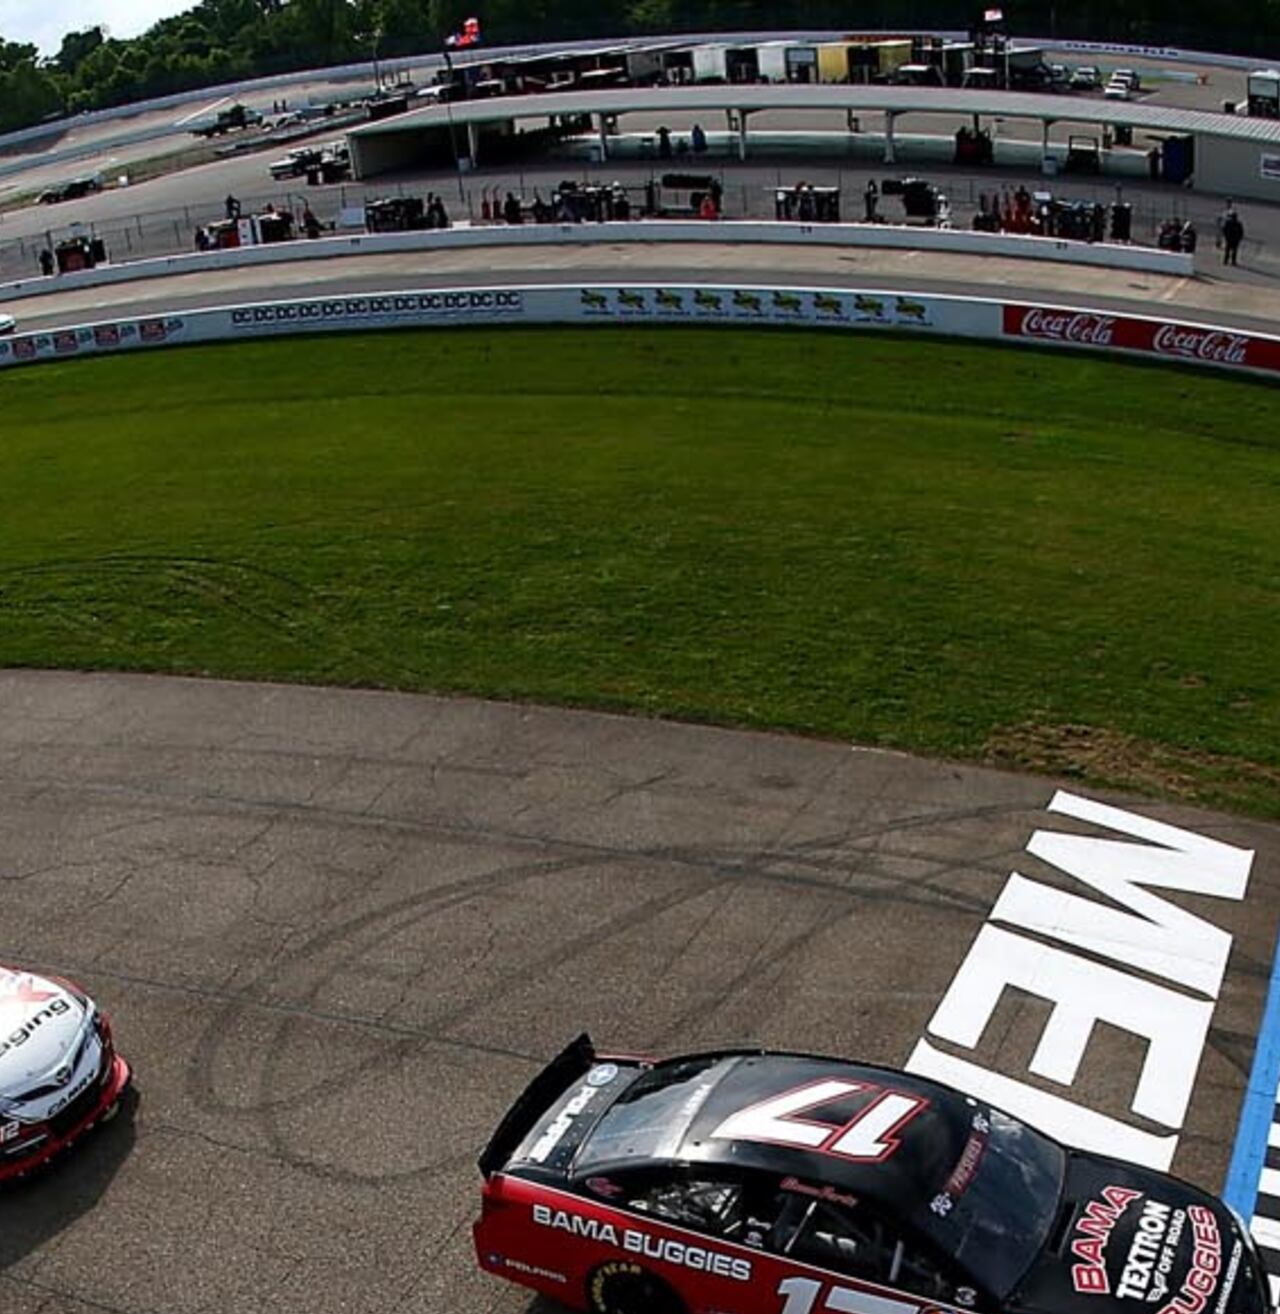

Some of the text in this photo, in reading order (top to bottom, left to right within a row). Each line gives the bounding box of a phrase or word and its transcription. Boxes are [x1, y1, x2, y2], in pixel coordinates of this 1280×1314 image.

[1022, 309, 1116, 345] Coca-Cola
[1153, 324, 1248, 364] Coca-Cola
[710, 1076, 930, 1162] 17
[533, 1204, 752, 1281] BAMA BUGGIES
[1071, 1185, 1144, 1294] BAMA
[1116, 1200, 1171, 1300] TEXTRON
[1158, 1208, 1186, 1274] OFF ROAD
